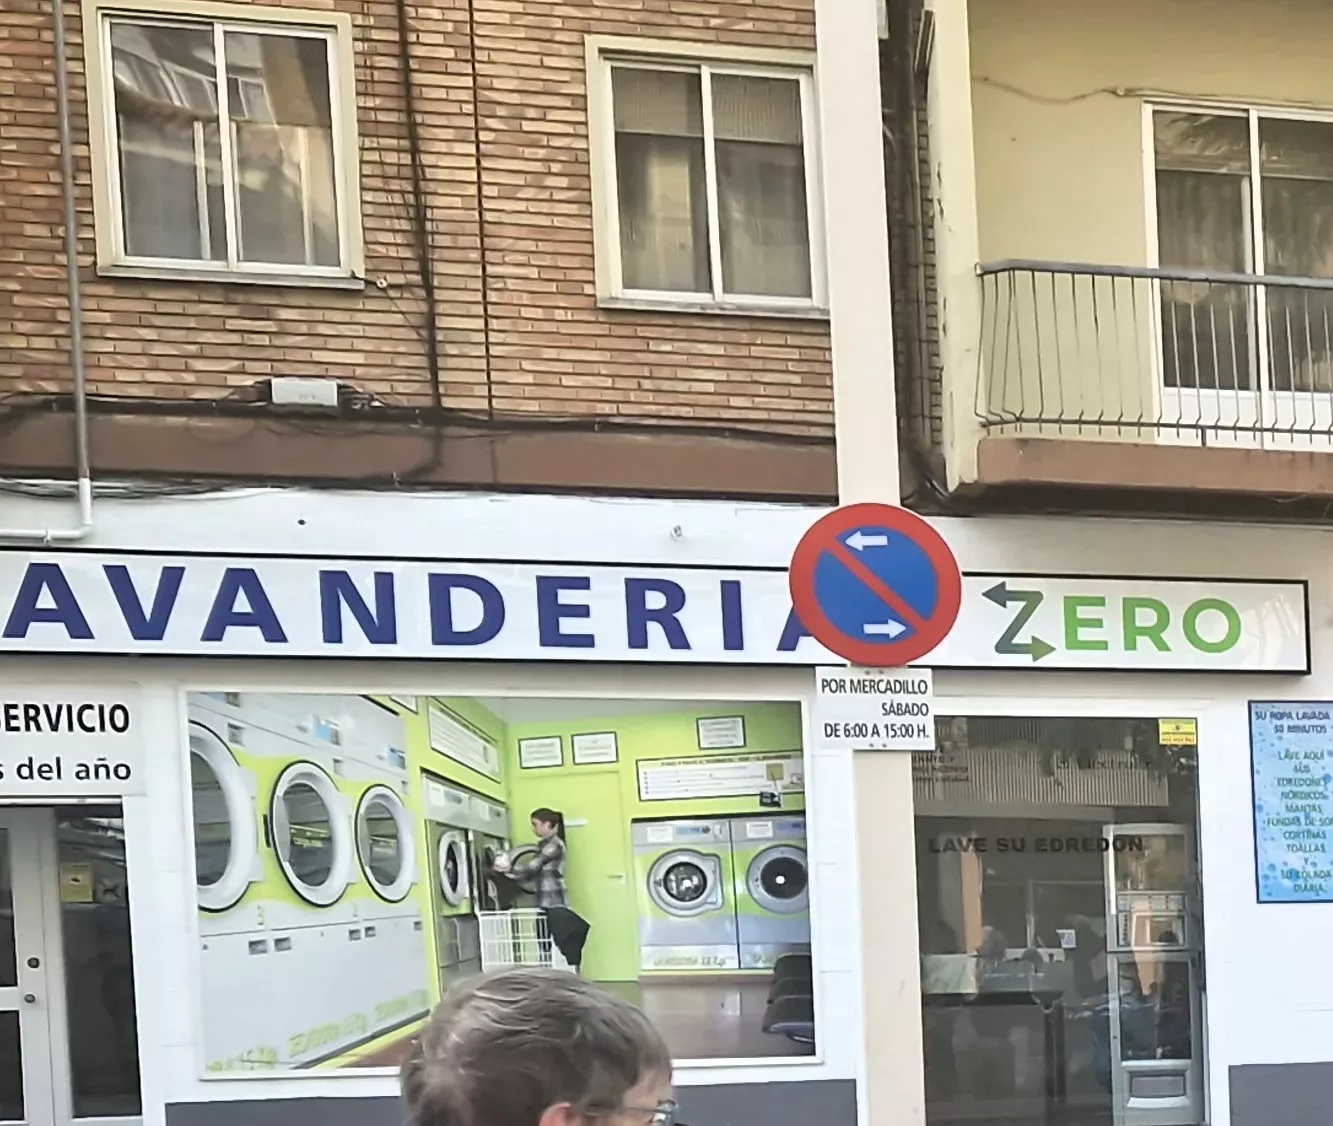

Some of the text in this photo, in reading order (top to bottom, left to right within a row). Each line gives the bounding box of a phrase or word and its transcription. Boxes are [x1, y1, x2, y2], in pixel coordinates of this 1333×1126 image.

[2, 562, 1242, 662] AVANDERI ZERO
[822, 678, 928, 695] POR MERCADILLO
[881, 700, 930, 716] SÁBADO
[0, 703, 130, 733] ERVICIO
[824, 723, 841, 738] DE
[844, 723, 868, 738] 6:00
[871, 723, 880, 738] A
[884, 723, 914, 738] 15:00
[16, 756, 131, 780] del año
[929, 837, 987, 854] LAVE
[996, 837, 1026, 852] SU
